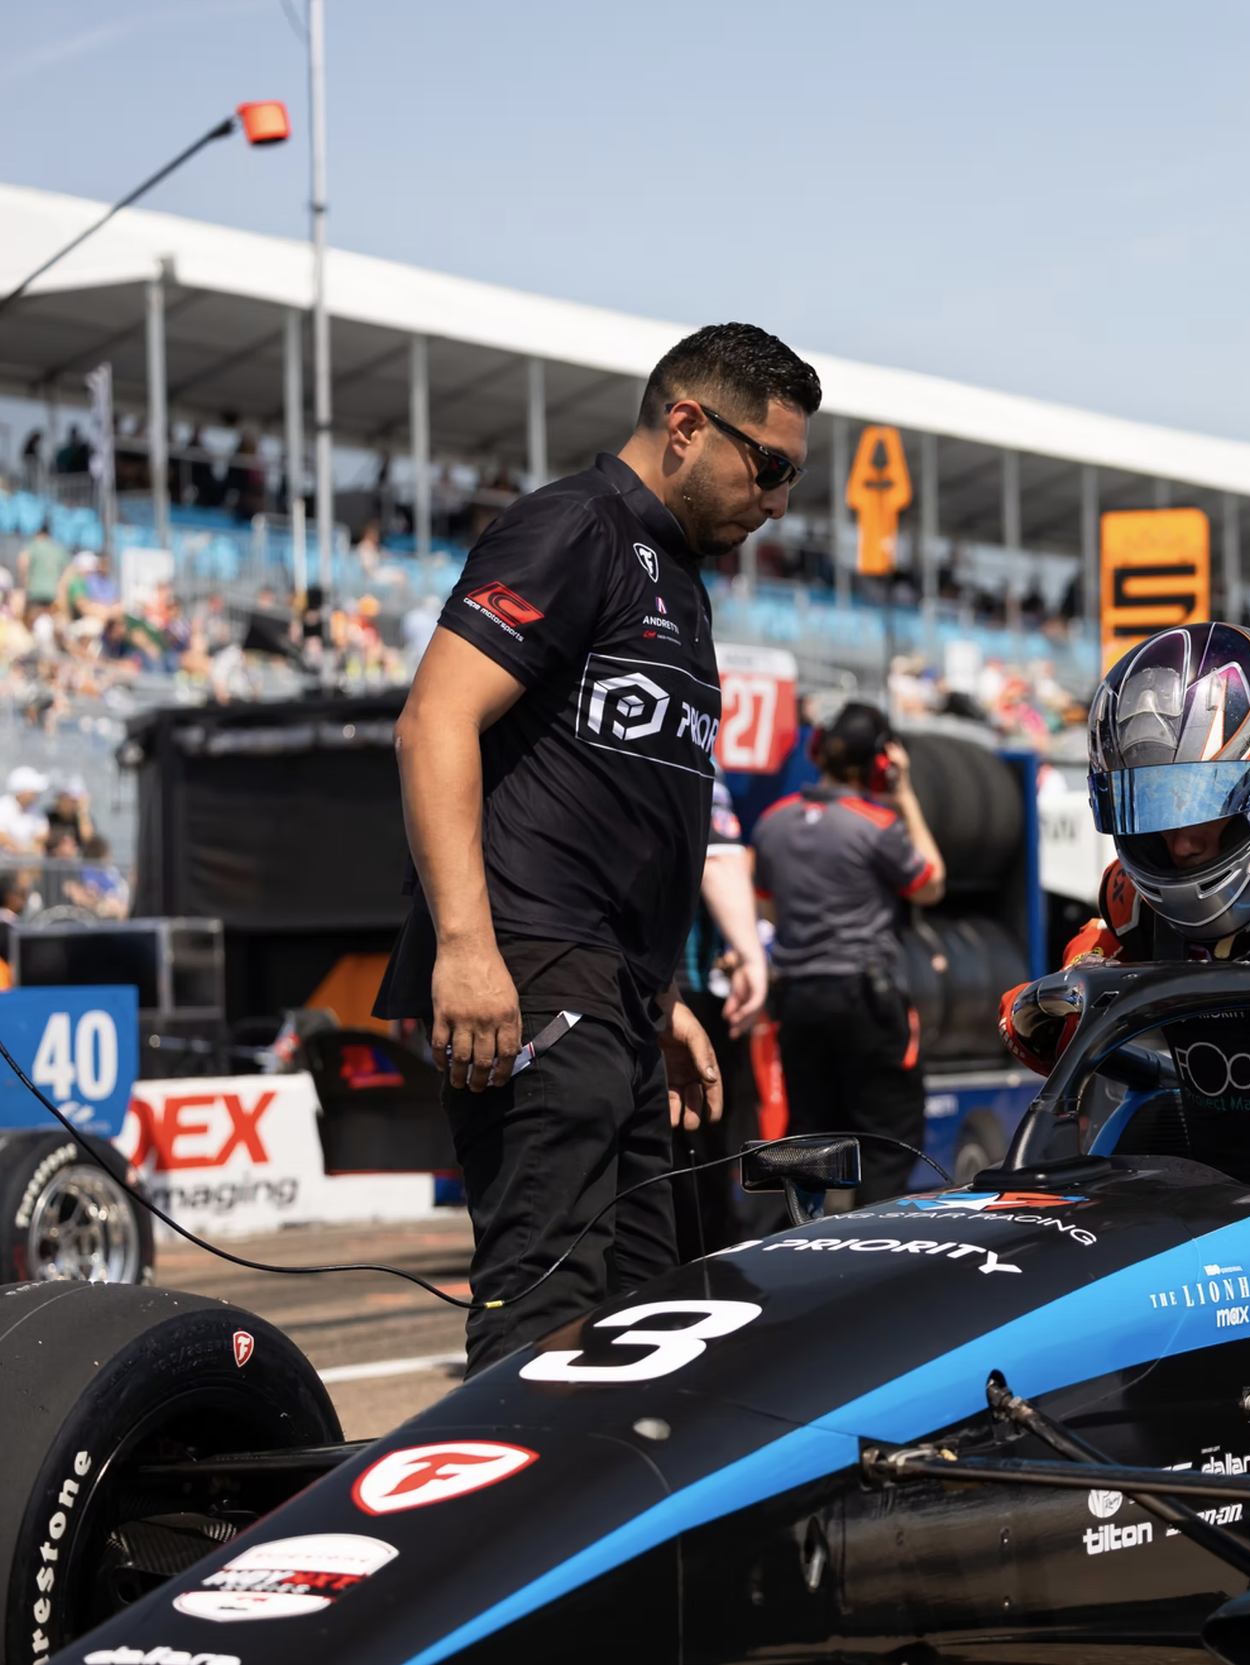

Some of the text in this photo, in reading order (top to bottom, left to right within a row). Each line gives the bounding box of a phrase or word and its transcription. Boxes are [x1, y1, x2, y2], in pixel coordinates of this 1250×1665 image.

[480, 607, 524, 642] motorsports
[722, 673, 779, 768] 27
[32, 1010, 118, 1101] 40
[878, 1212, 968, 1220] STAR
[971, 1212, 1098, 1247] RACING
[763, 1238, 1022, 1275] PRIORITY
[1150, 1291, 1178, 1308] THE
[1216, 1305, 1249, 1328] max
[519, 1300, 762, 1382] 3
[1083, 1521, 1153, 1555] tilton
[32, 1450, 92, 1665] restone
